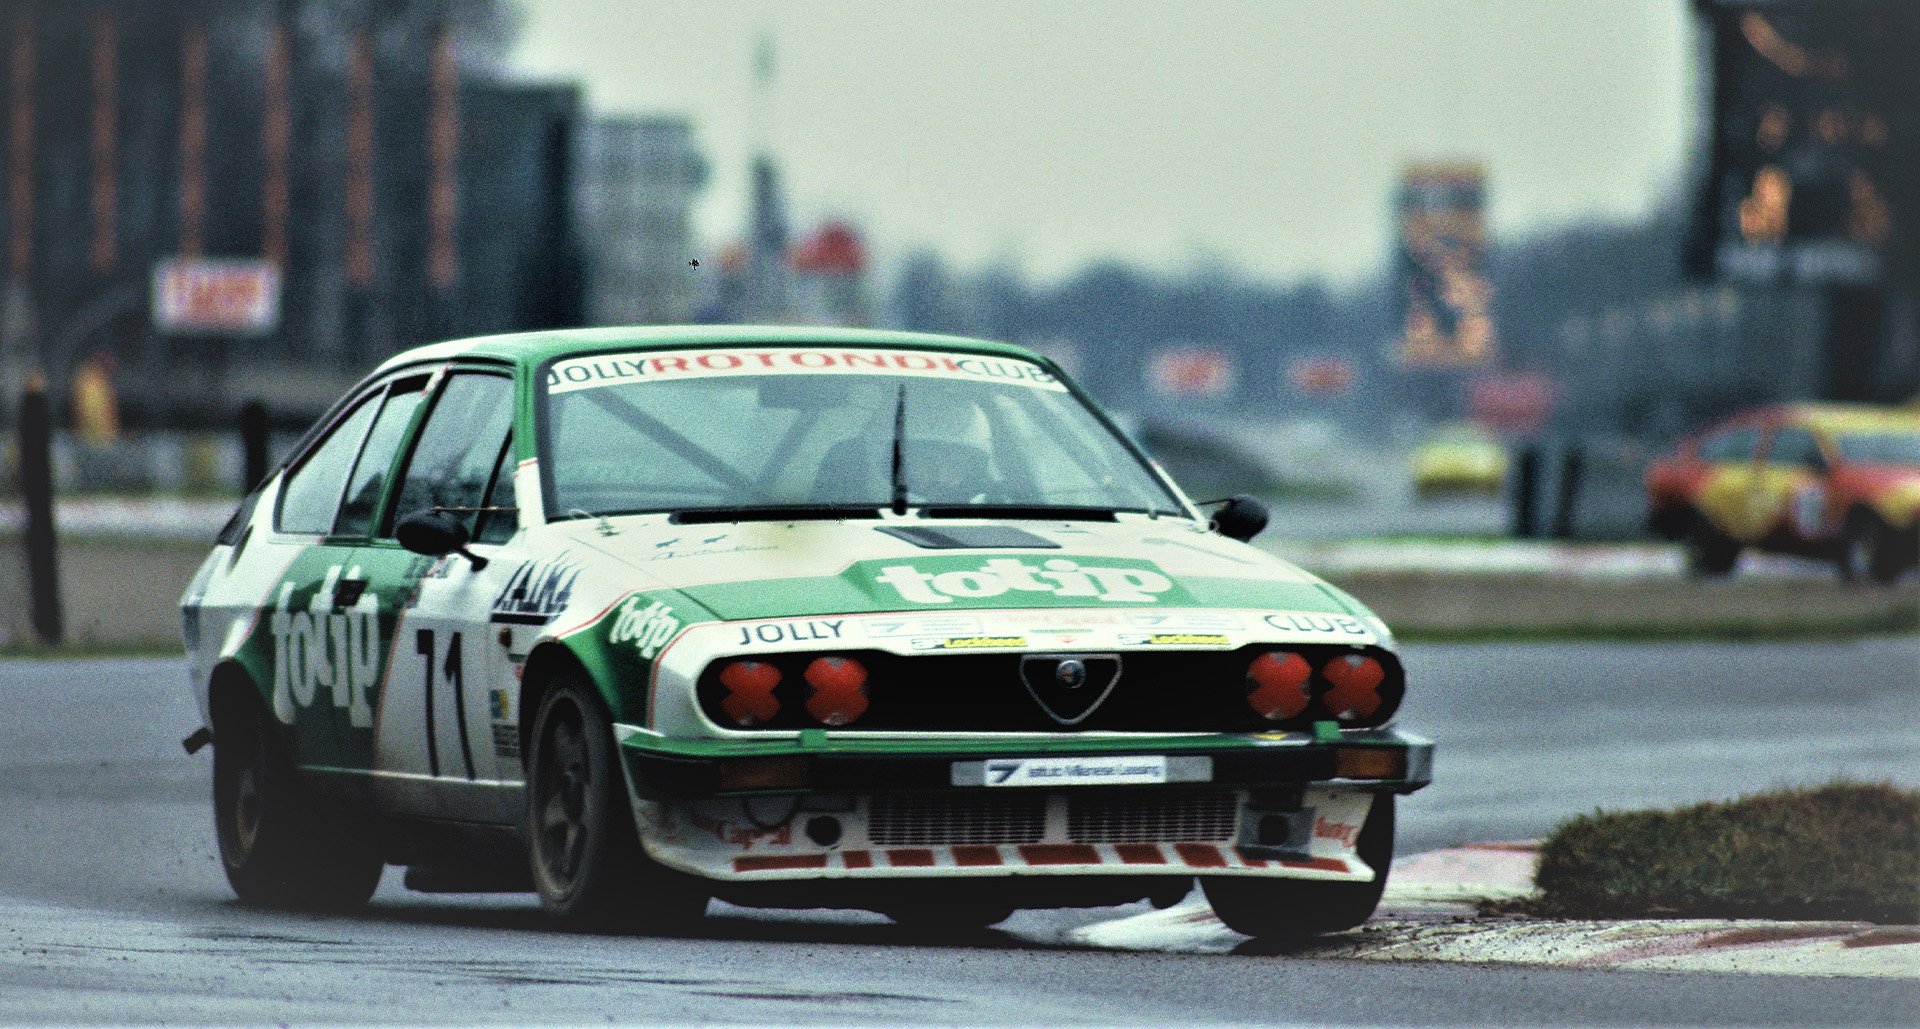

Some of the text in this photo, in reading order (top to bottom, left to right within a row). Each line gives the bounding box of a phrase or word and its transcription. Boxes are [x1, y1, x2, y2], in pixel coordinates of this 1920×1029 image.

[547, 353, 1057, 386] JOLLY ROTONDI CLUB
[876, 558, 1172, 603] totip
[271, 565, 380, 728] totip
[609, 596, 680, 660] totip
[740, 620, 844, 645] JOLLY
[1264, 615, 1365, 634] CLUB
[417, 629, 475, 779] 71
